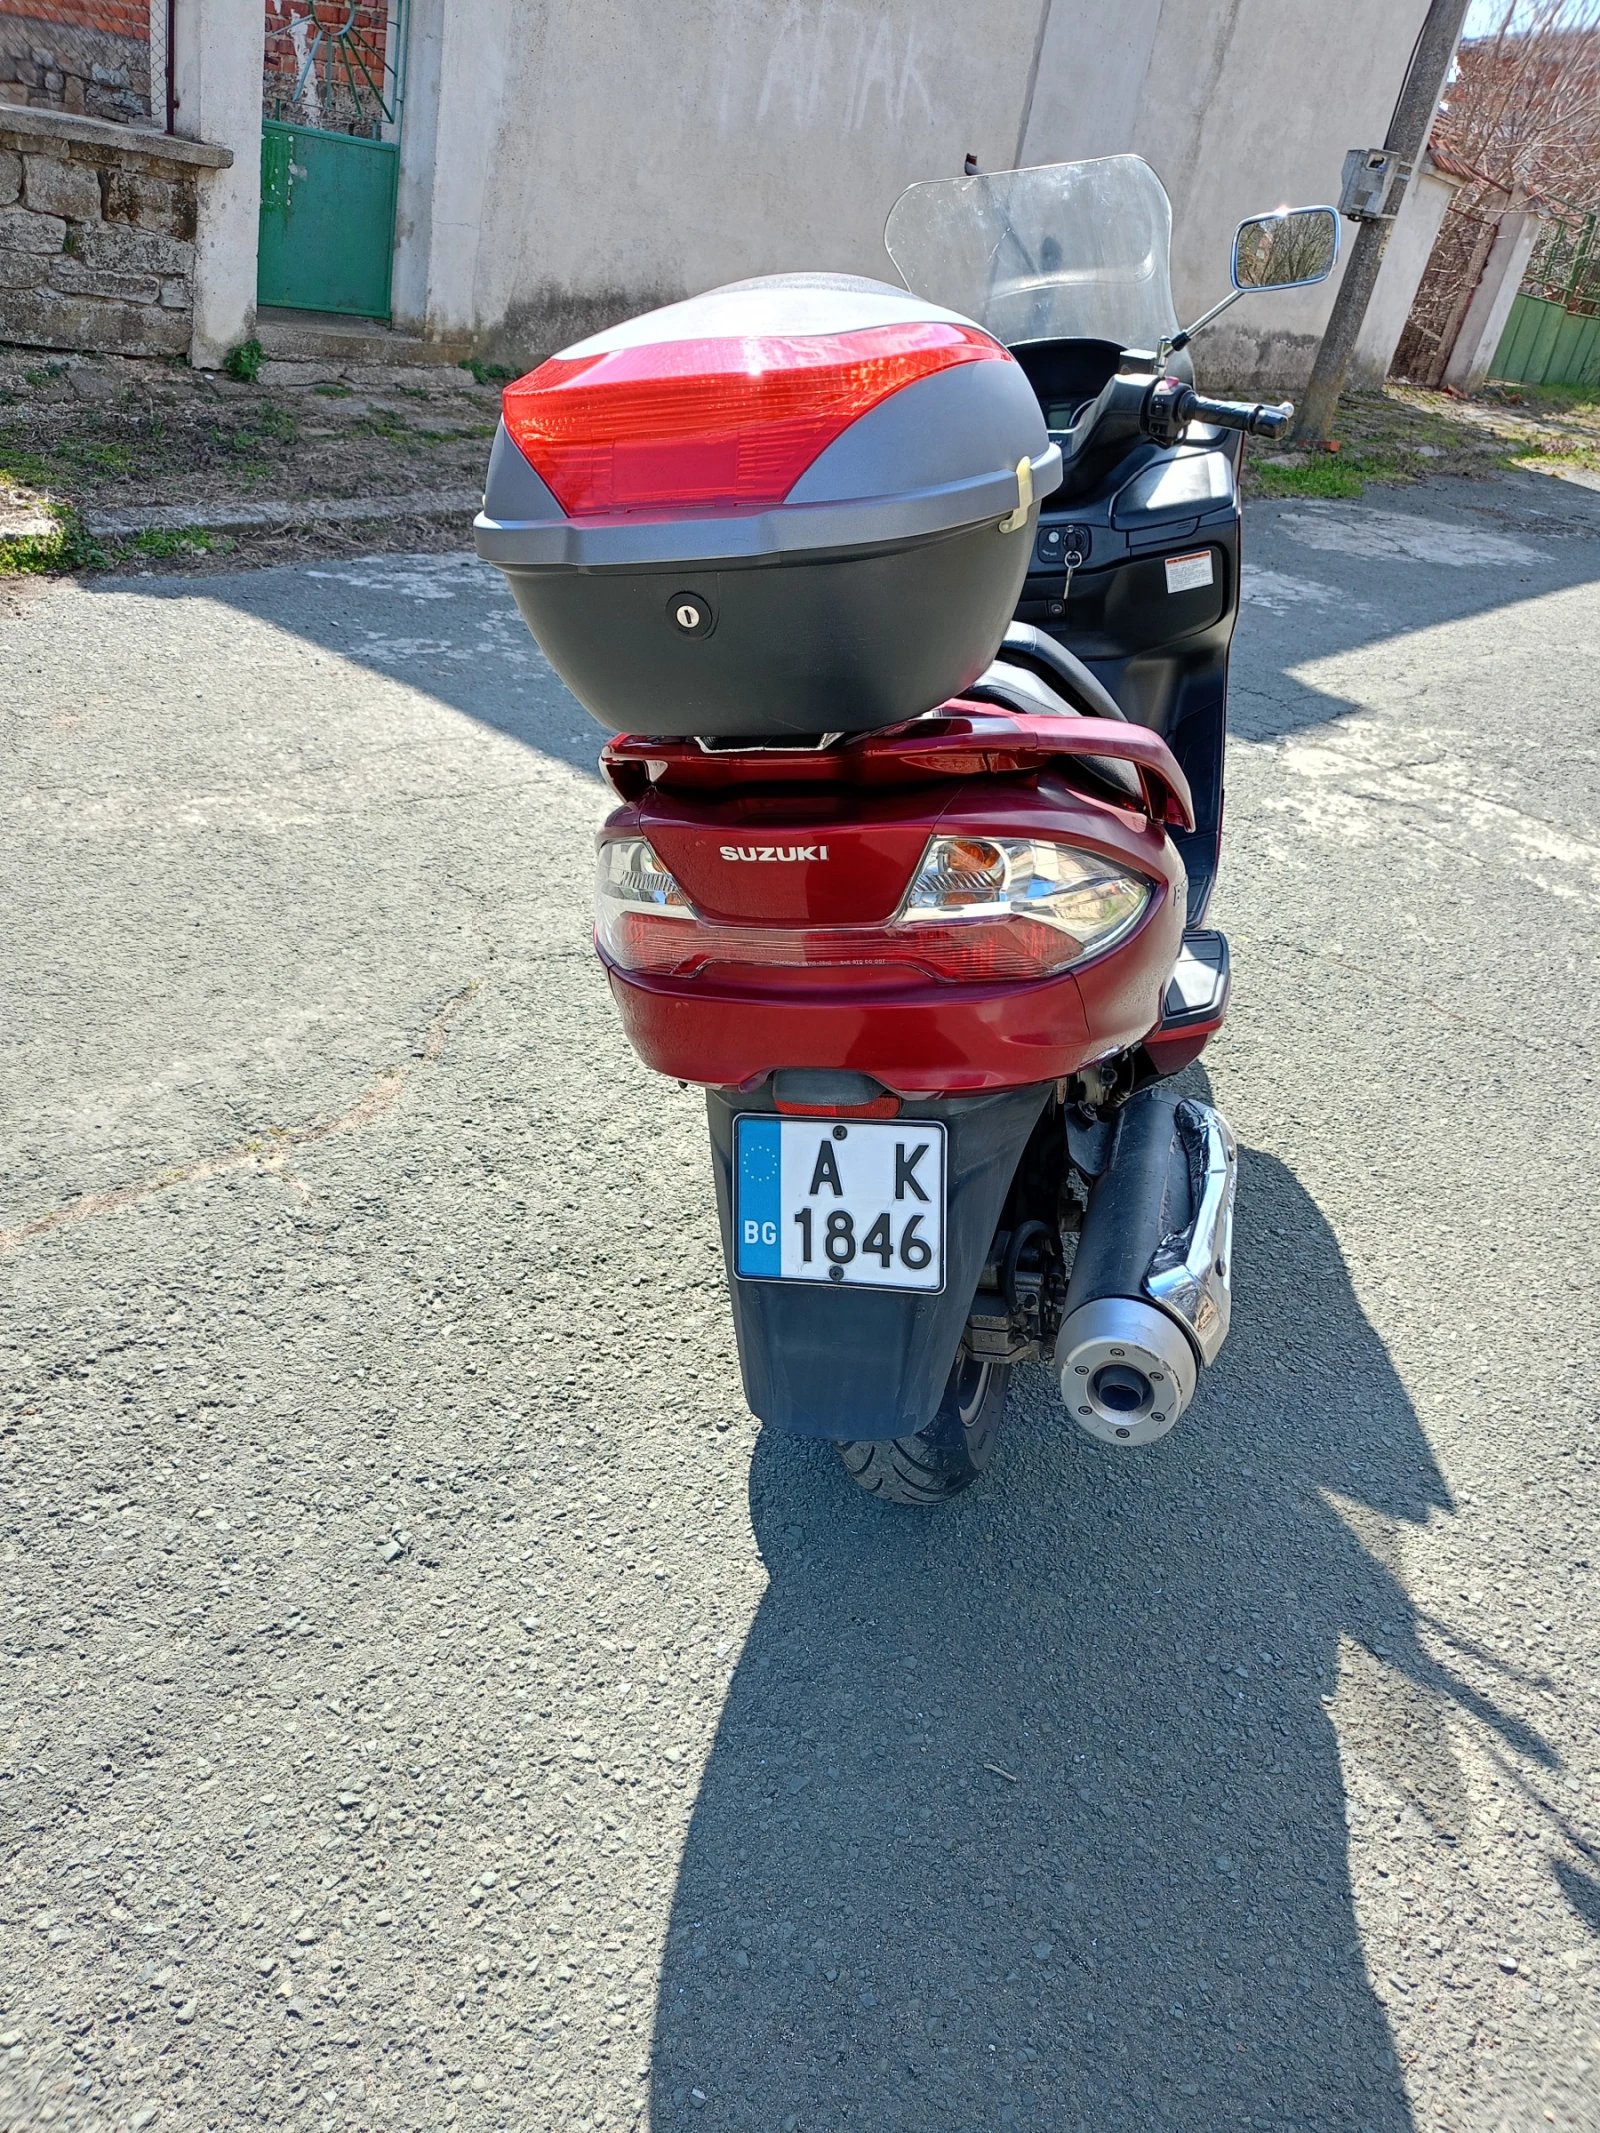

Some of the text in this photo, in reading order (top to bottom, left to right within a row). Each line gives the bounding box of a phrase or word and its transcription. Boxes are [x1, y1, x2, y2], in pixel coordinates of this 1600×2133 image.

[719, 845, 828, 861] SUZUKI
[809, 1140, 931, 1202] A K
[744, 1220, 777, 1244] BG
[794, 1207, 932, 1270] 1846
